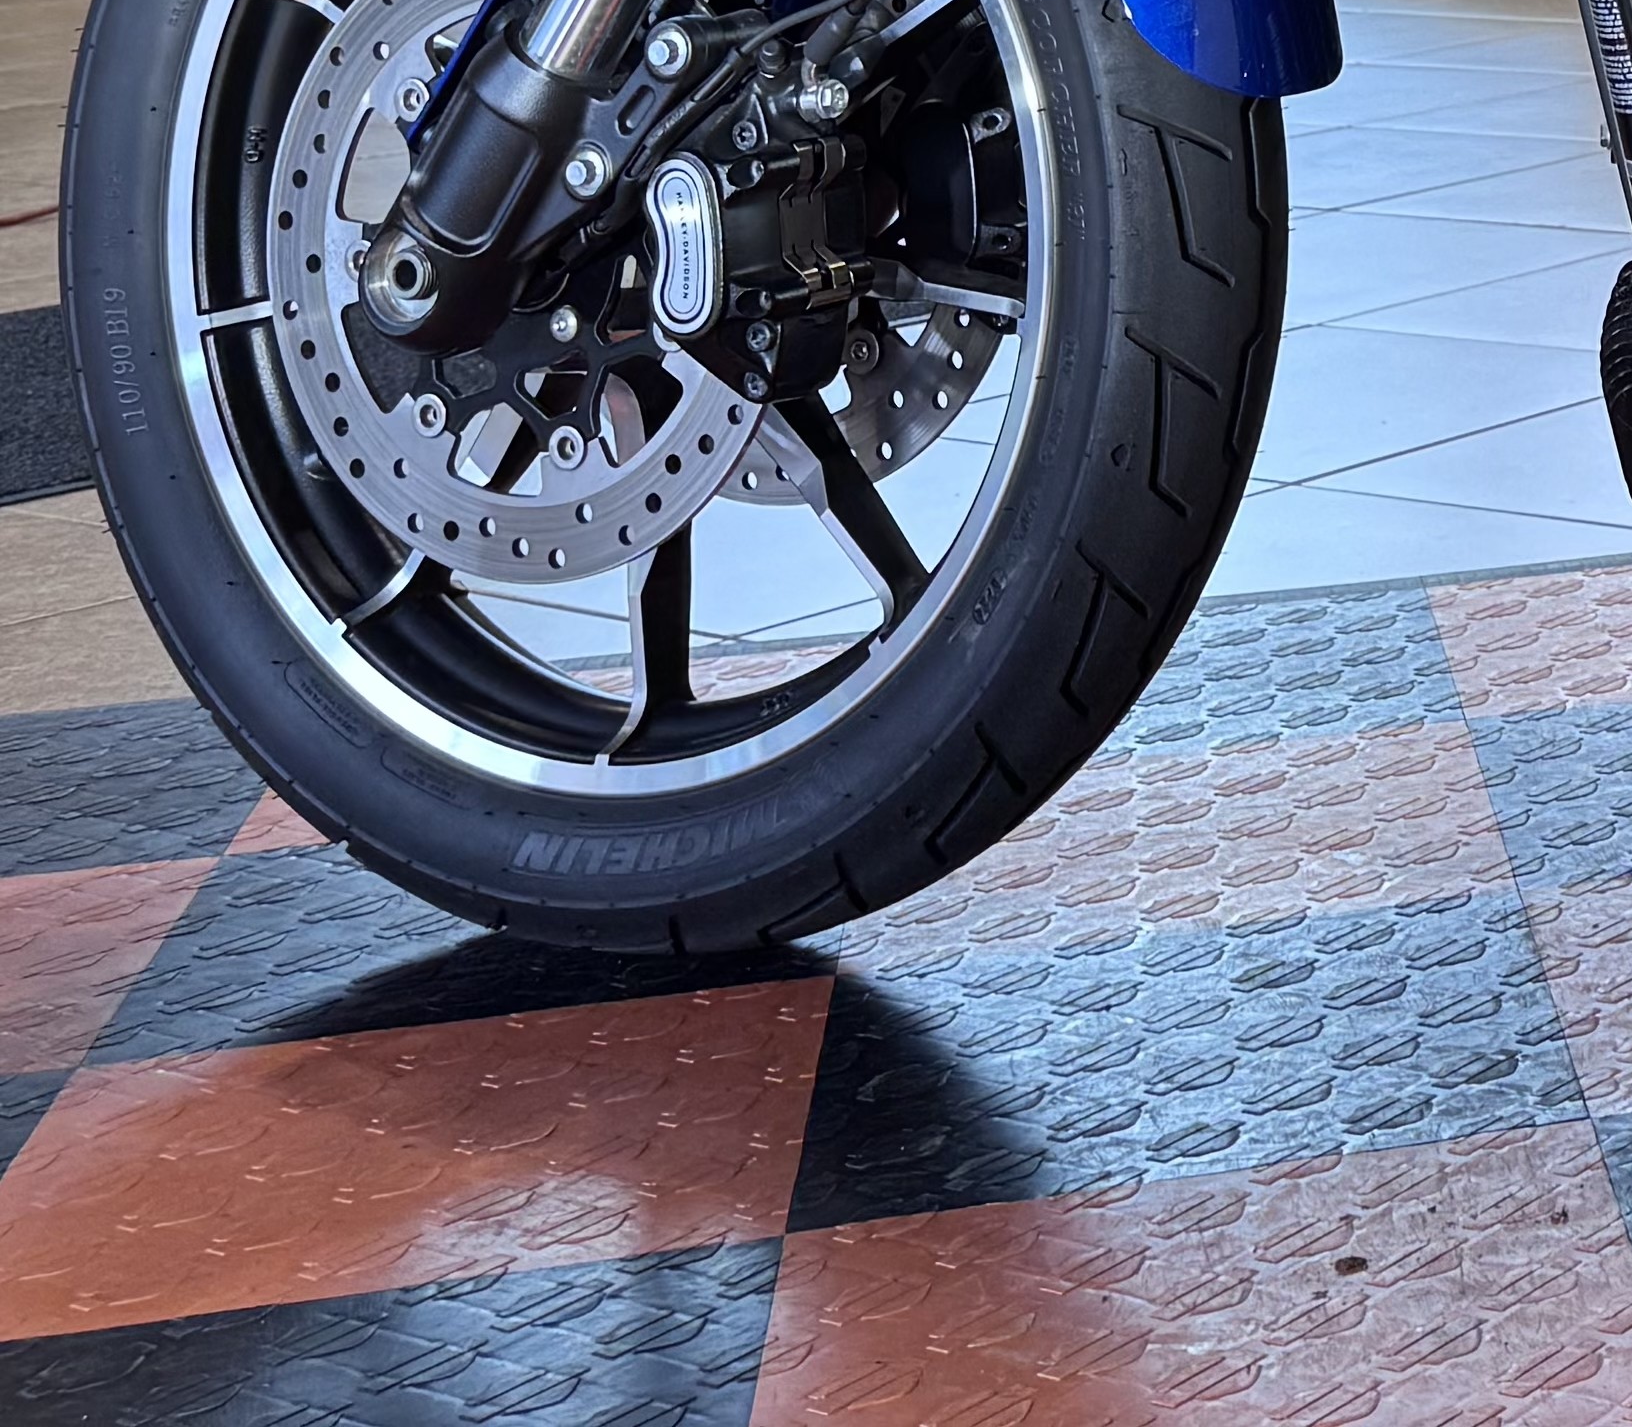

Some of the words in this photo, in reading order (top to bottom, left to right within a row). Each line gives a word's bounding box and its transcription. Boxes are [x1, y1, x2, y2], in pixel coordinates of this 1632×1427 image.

[675, 191, 691, 300] HAEY-DAVIDSON
[111, 344, 149, 436] 110/90
[509, 794, 787, 876] MICHELIN
